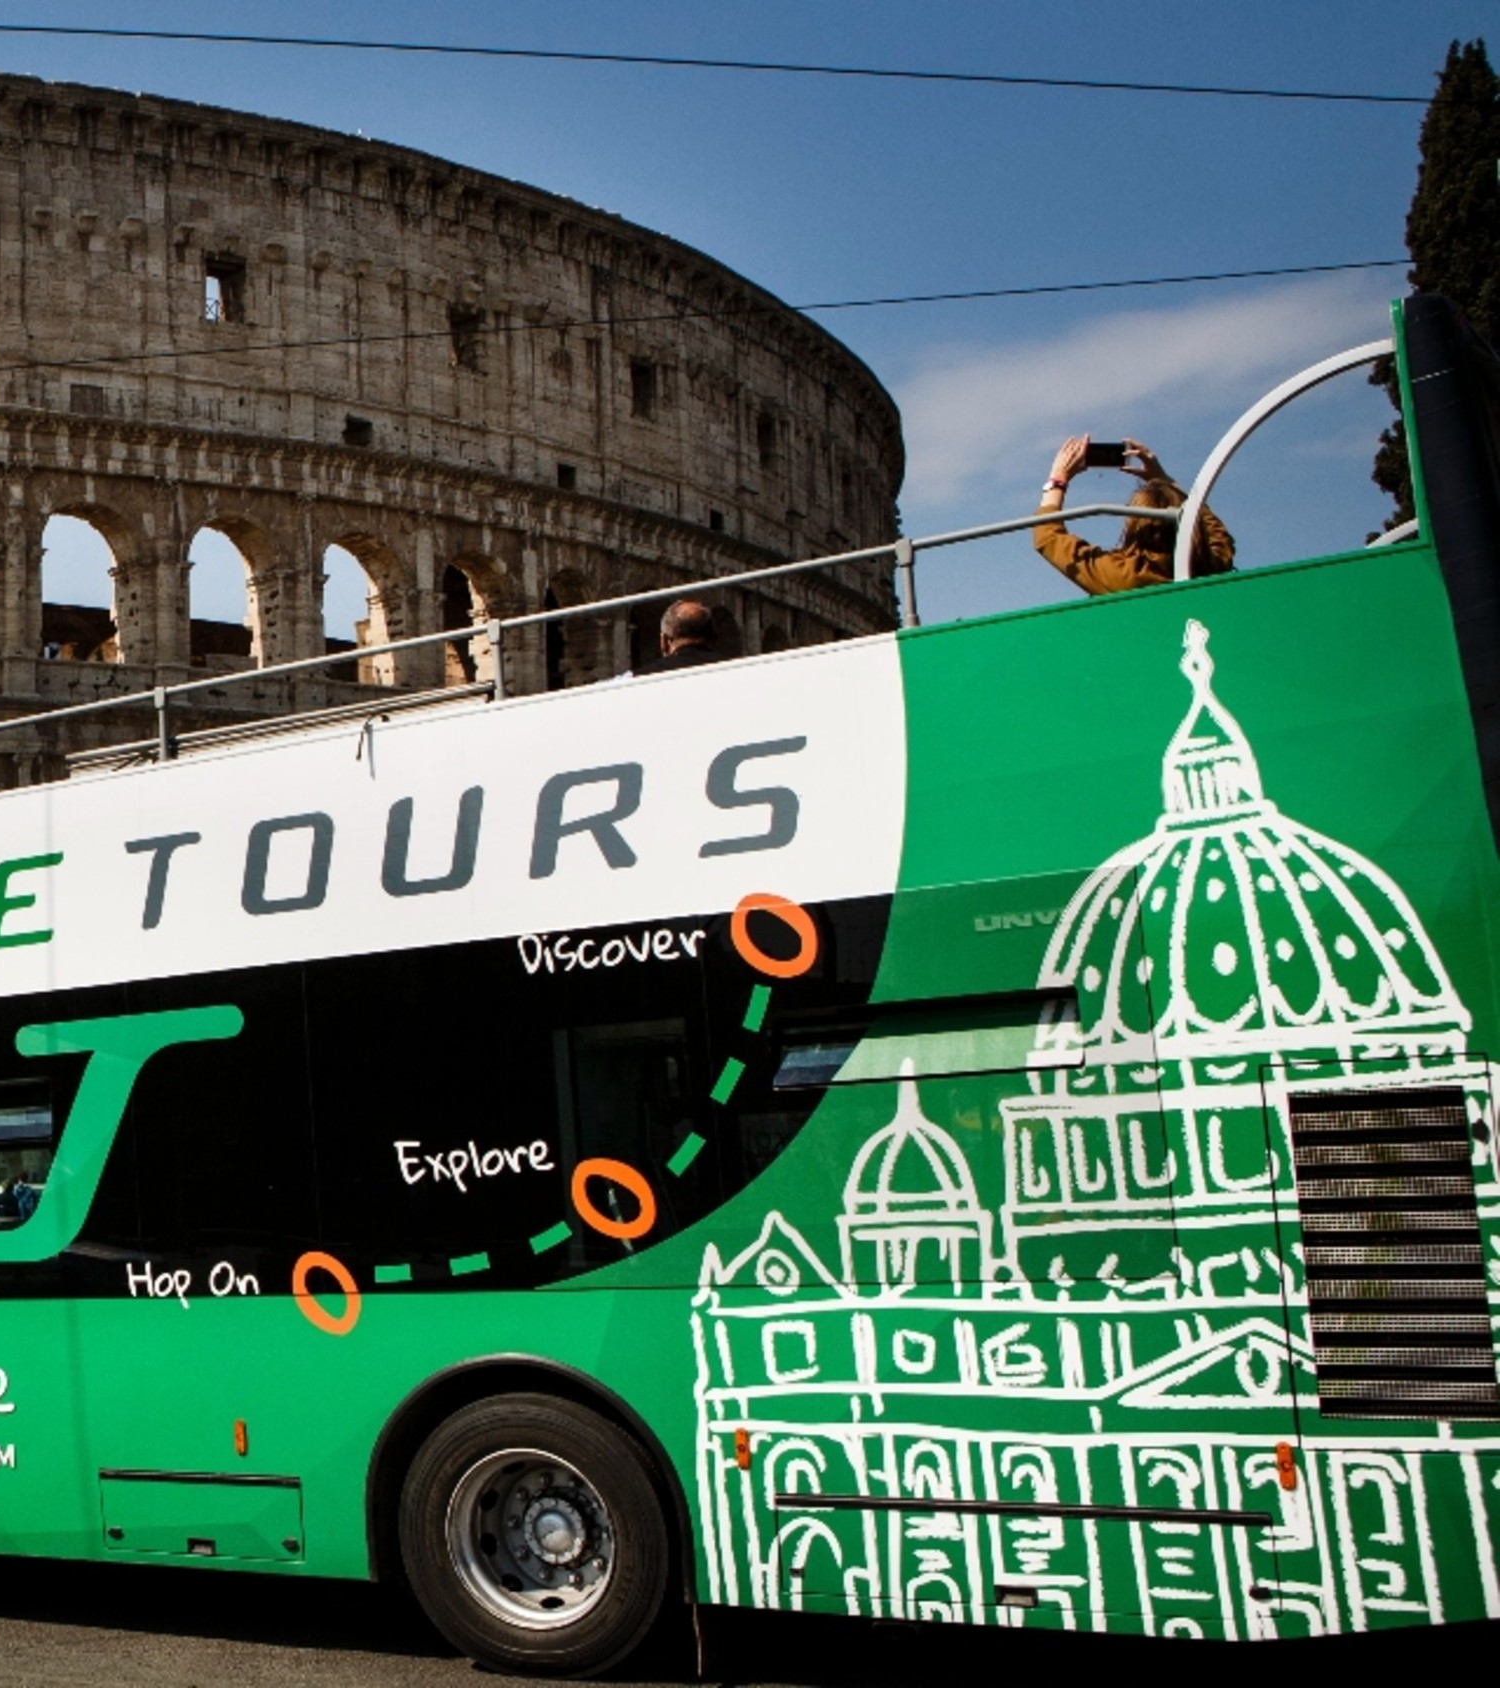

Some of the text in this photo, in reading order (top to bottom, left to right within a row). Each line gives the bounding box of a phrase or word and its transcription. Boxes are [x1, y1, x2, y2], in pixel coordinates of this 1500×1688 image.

[124, 735, 807, 930] TOURS
[974, 910, 1062, 932] UNV
[517, 930, 706, 974] Discover
[393, 1139, 555, 1193] Explore
[126, 1261, 260, 1310] Hop On
